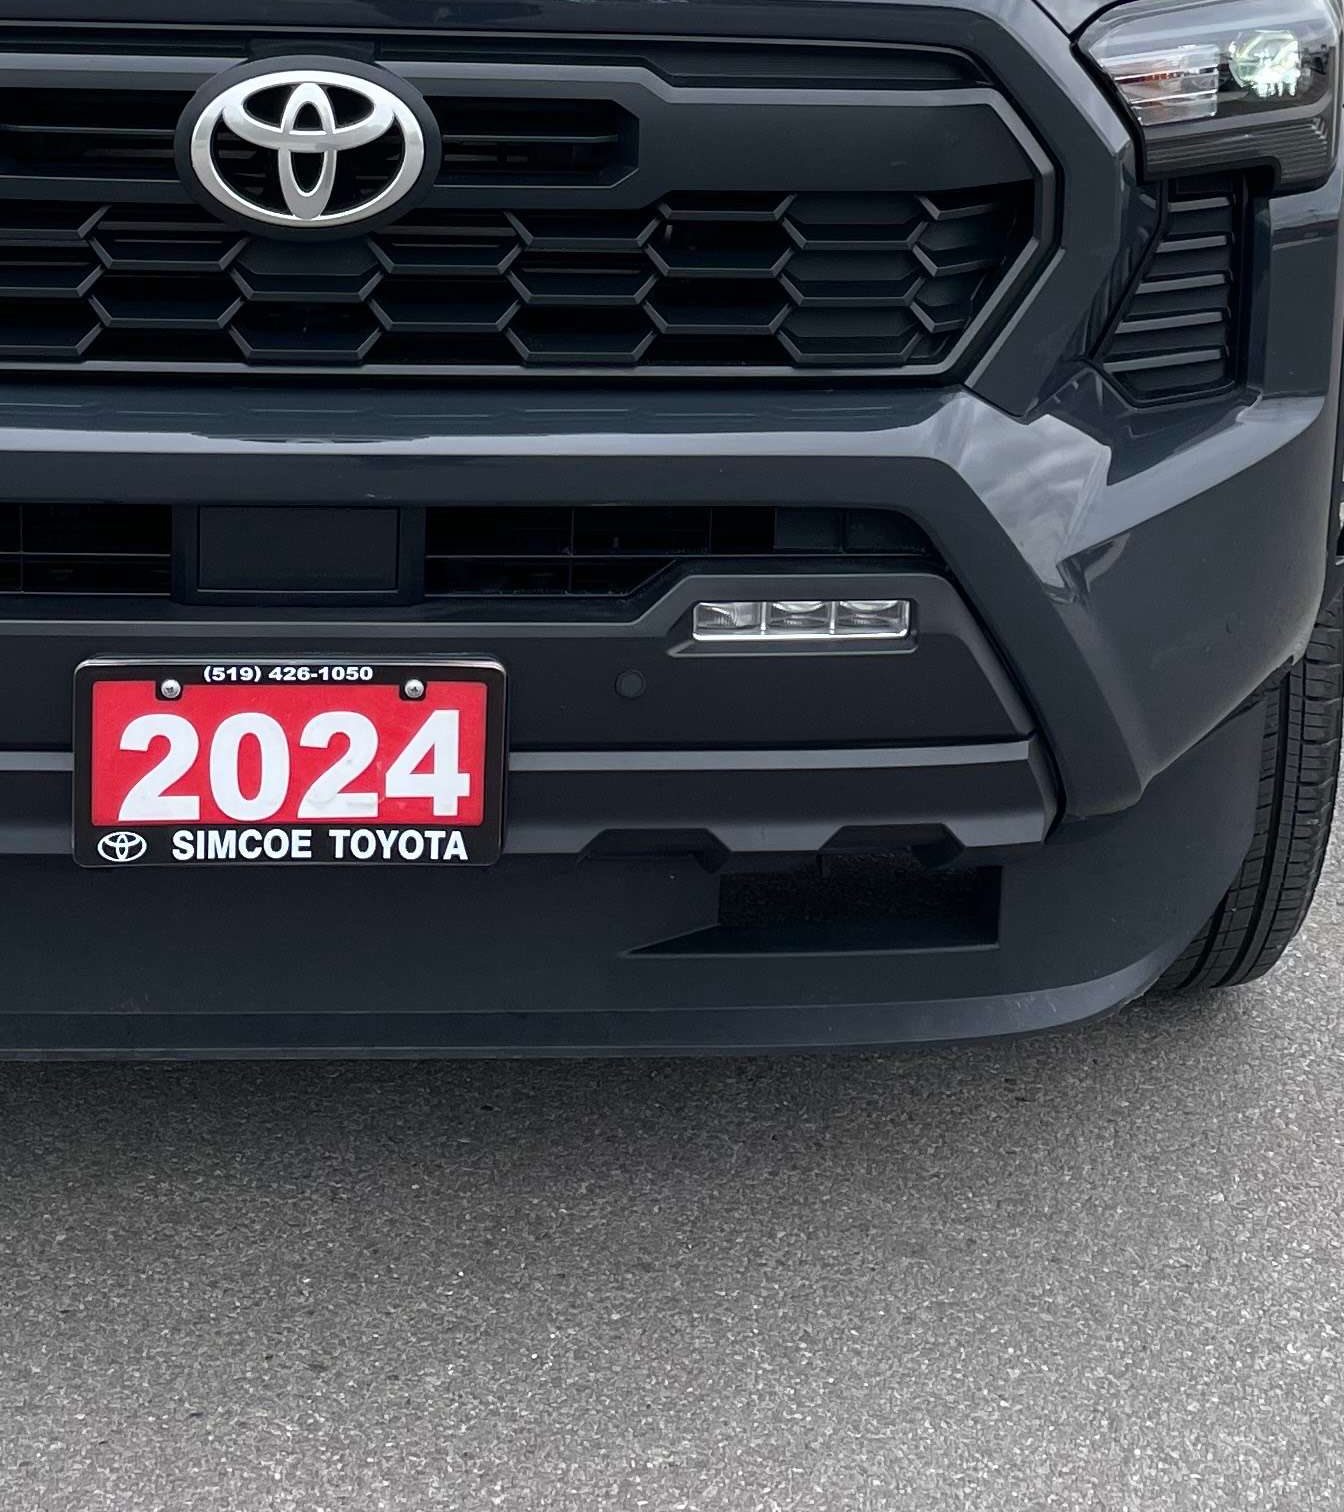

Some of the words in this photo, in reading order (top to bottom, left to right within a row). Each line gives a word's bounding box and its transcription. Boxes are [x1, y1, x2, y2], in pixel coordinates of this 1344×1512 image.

[203, 665, 262, 683] (519)
[268, 666, 374, 681] 426-1050
[117, 708, 471, 822] 2024
[171, 828, 313, 859] SIMCOE
[328, 828, 469, 861] TOYOTA
